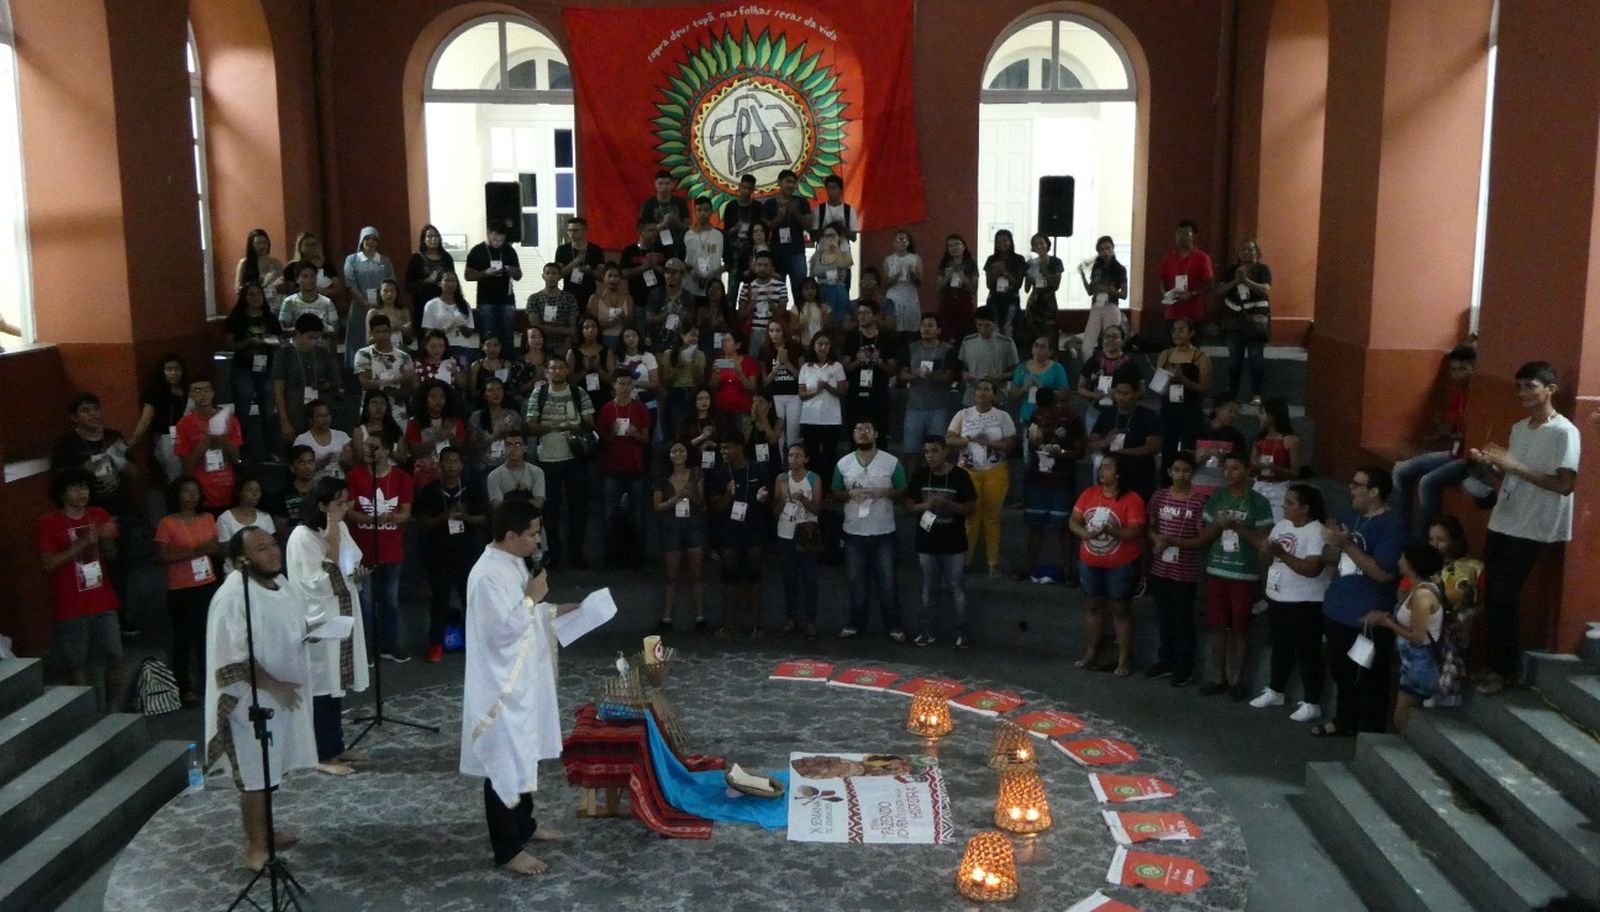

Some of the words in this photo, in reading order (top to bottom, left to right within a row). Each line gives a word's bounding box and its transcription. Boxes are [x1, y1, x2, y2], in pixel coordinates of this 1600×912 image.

[670, 25, 690, 41] deus
[719, 9, 738, 19] nas
[738, 5, 771, 16] folhas
[803, 17, 817, 29] da
[819, 25, 838, 41] vida
